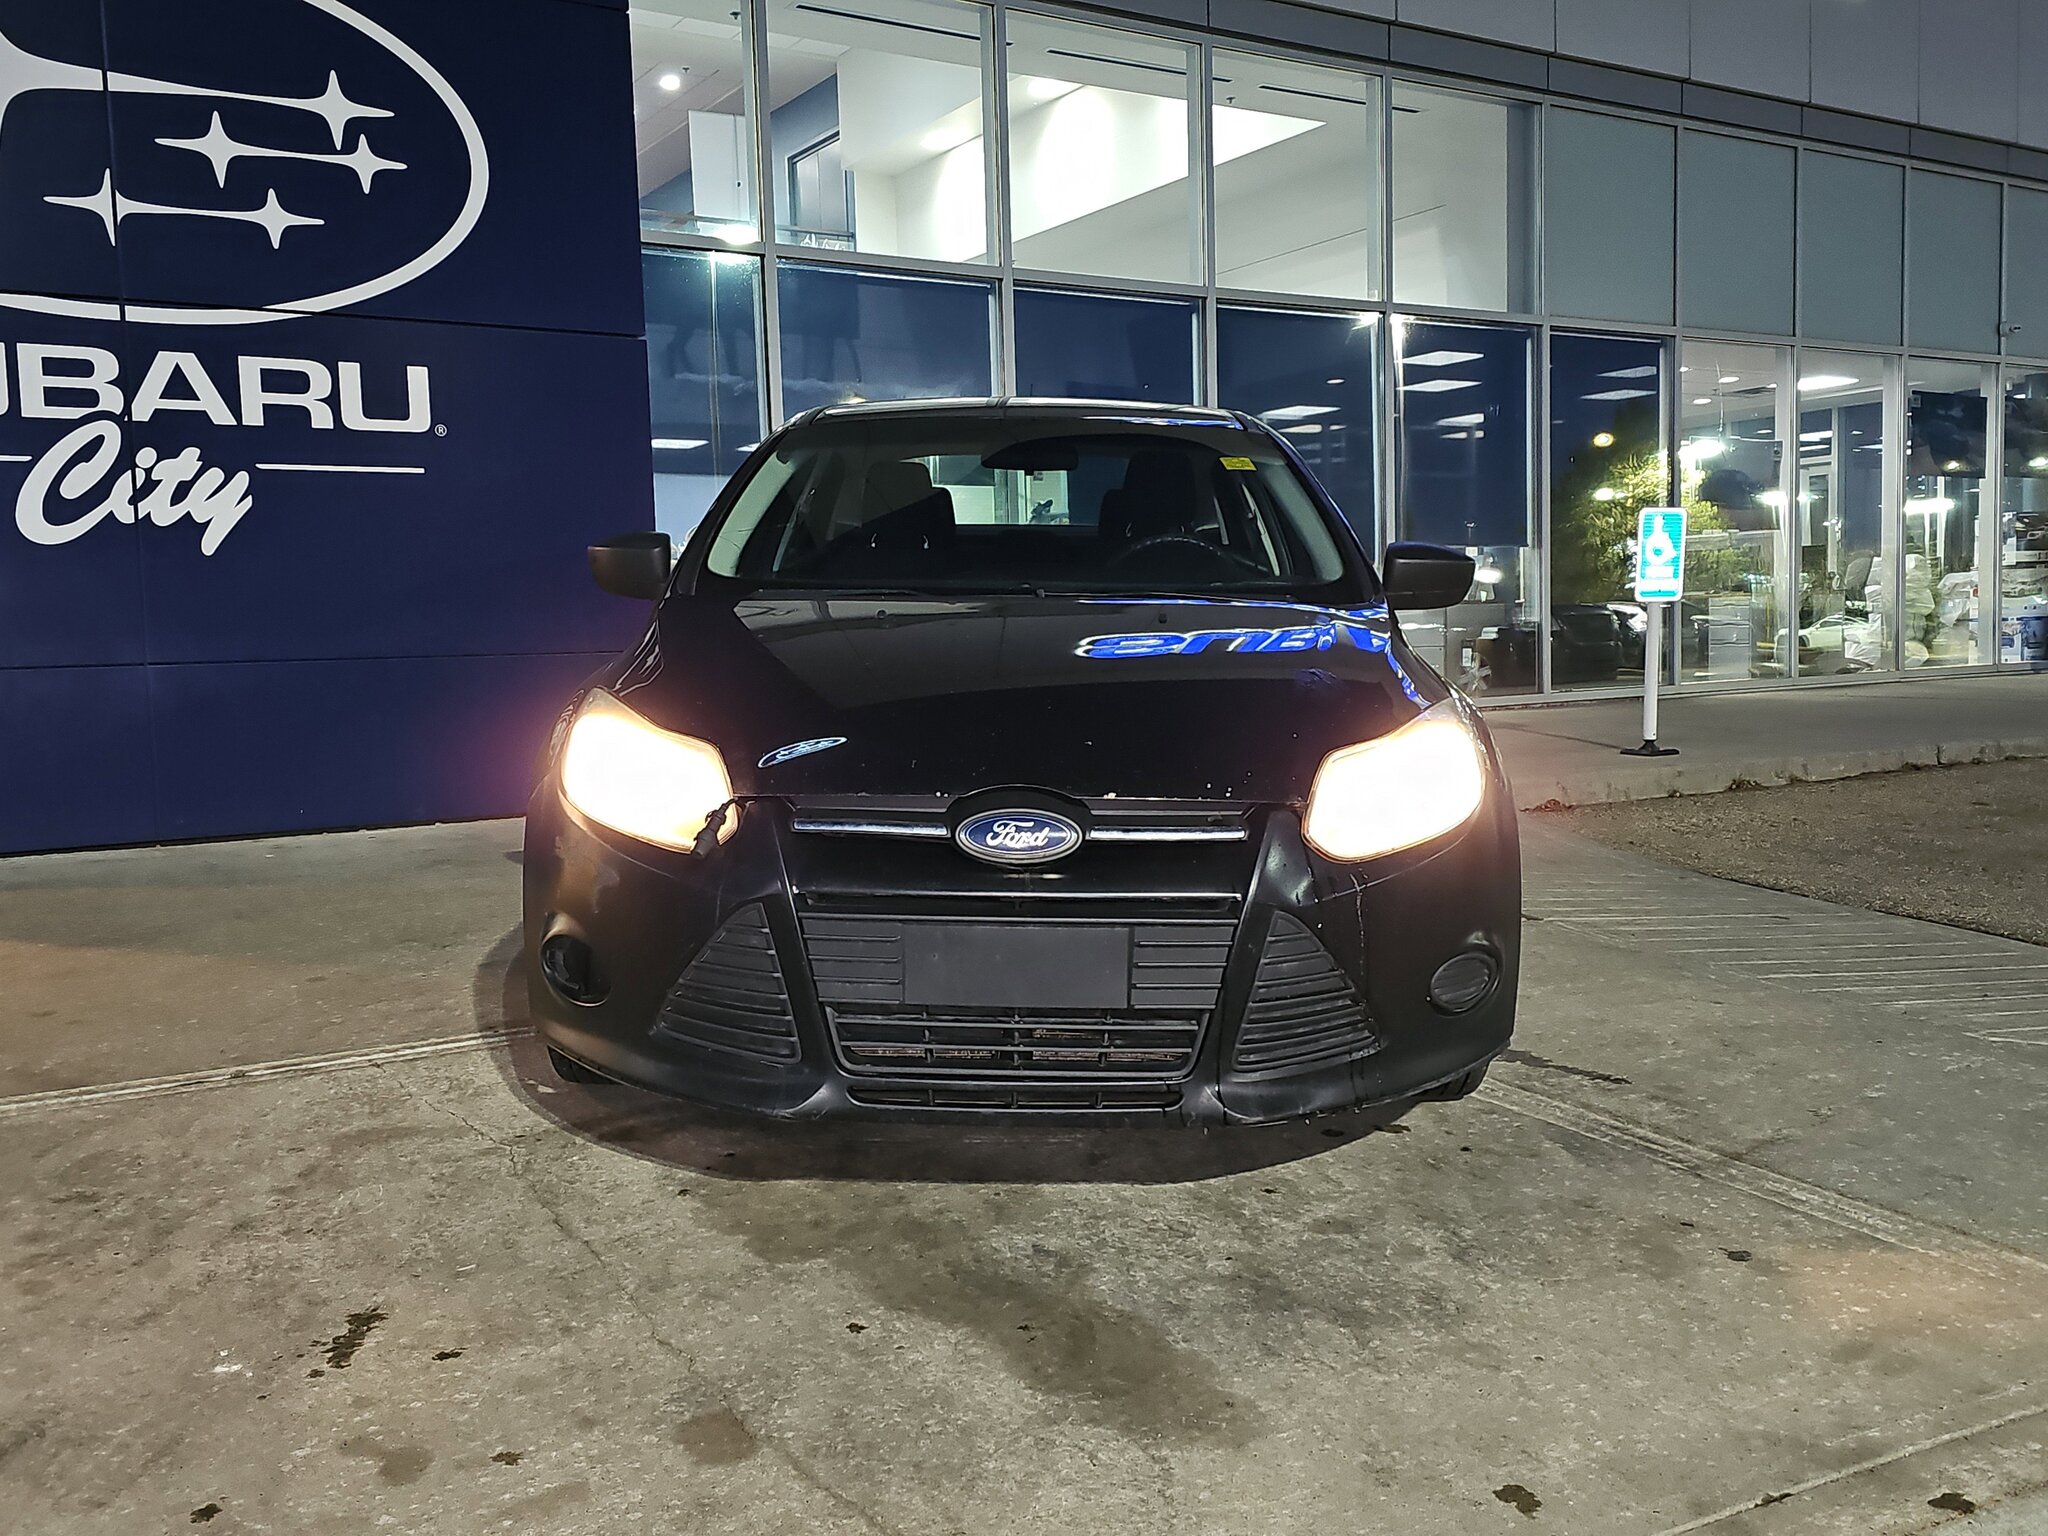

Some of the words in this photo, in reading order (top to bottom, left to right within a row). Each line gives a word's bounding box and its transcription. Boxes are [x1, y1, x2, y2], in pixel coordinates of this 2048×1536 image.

[0, 342, 431, 433] BARU
[15, 420, 253, 557] City
[986, 820, 1049, 848] Ford
